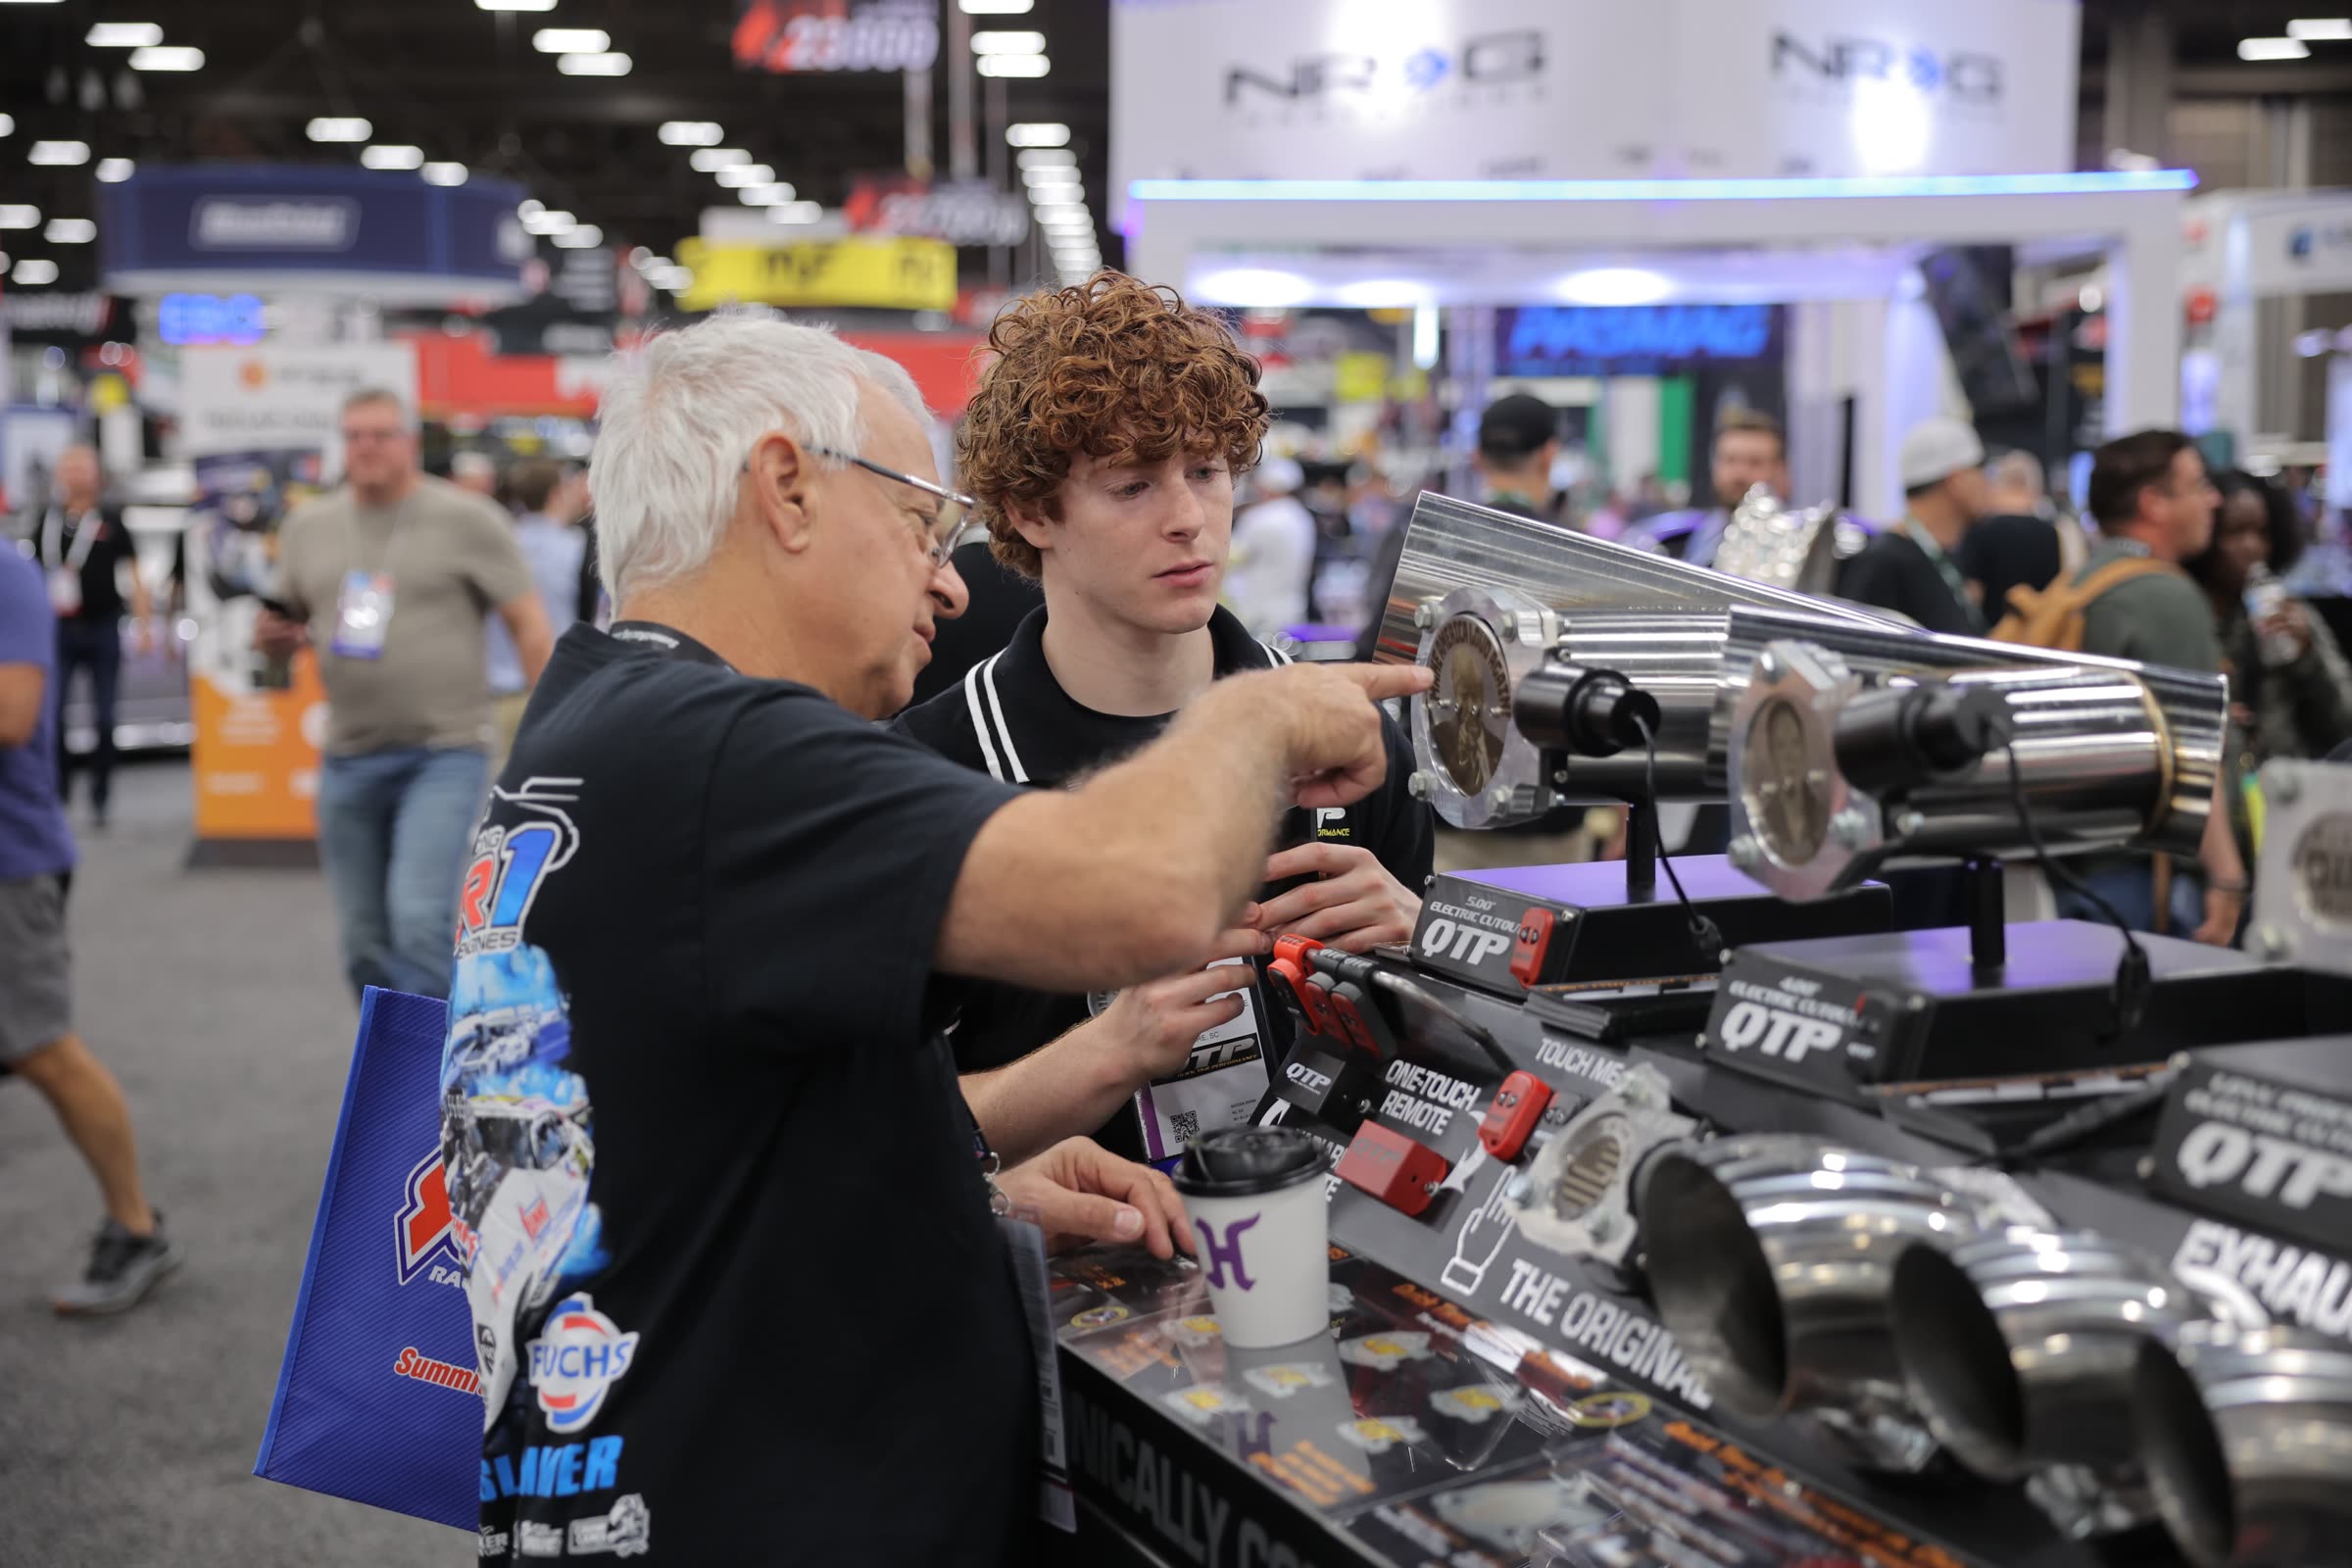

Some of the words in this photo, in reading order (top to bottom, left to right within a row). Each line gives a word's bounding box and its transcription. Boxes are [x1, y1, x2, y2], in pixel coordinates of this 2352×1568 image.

[1488, 648, 1512, 718] AGAIN
[1430, 901, 1480, 923] ELECTRIC
[1421, 918, 1510, 965] QTP
[1720, 1001, 1843, 1063] QTP
[1286, 1062, 1332, 1088] QTP
[1536, 1038, 1594, 1077] TOUCH
[1385, 1059, 1482, 1111] ONE-TOUCH
[1380, 1090, 1453, 1136] REMOTE
[1352, 1137, 1403, 1162] QTP
[2177, 1120, 2352, 1210] QTP
[1196, 1211, 1261, 1290] H
[1500, 1258, 1571, 1326] THE
[532, 1340, 630, 1379] FUCHS
